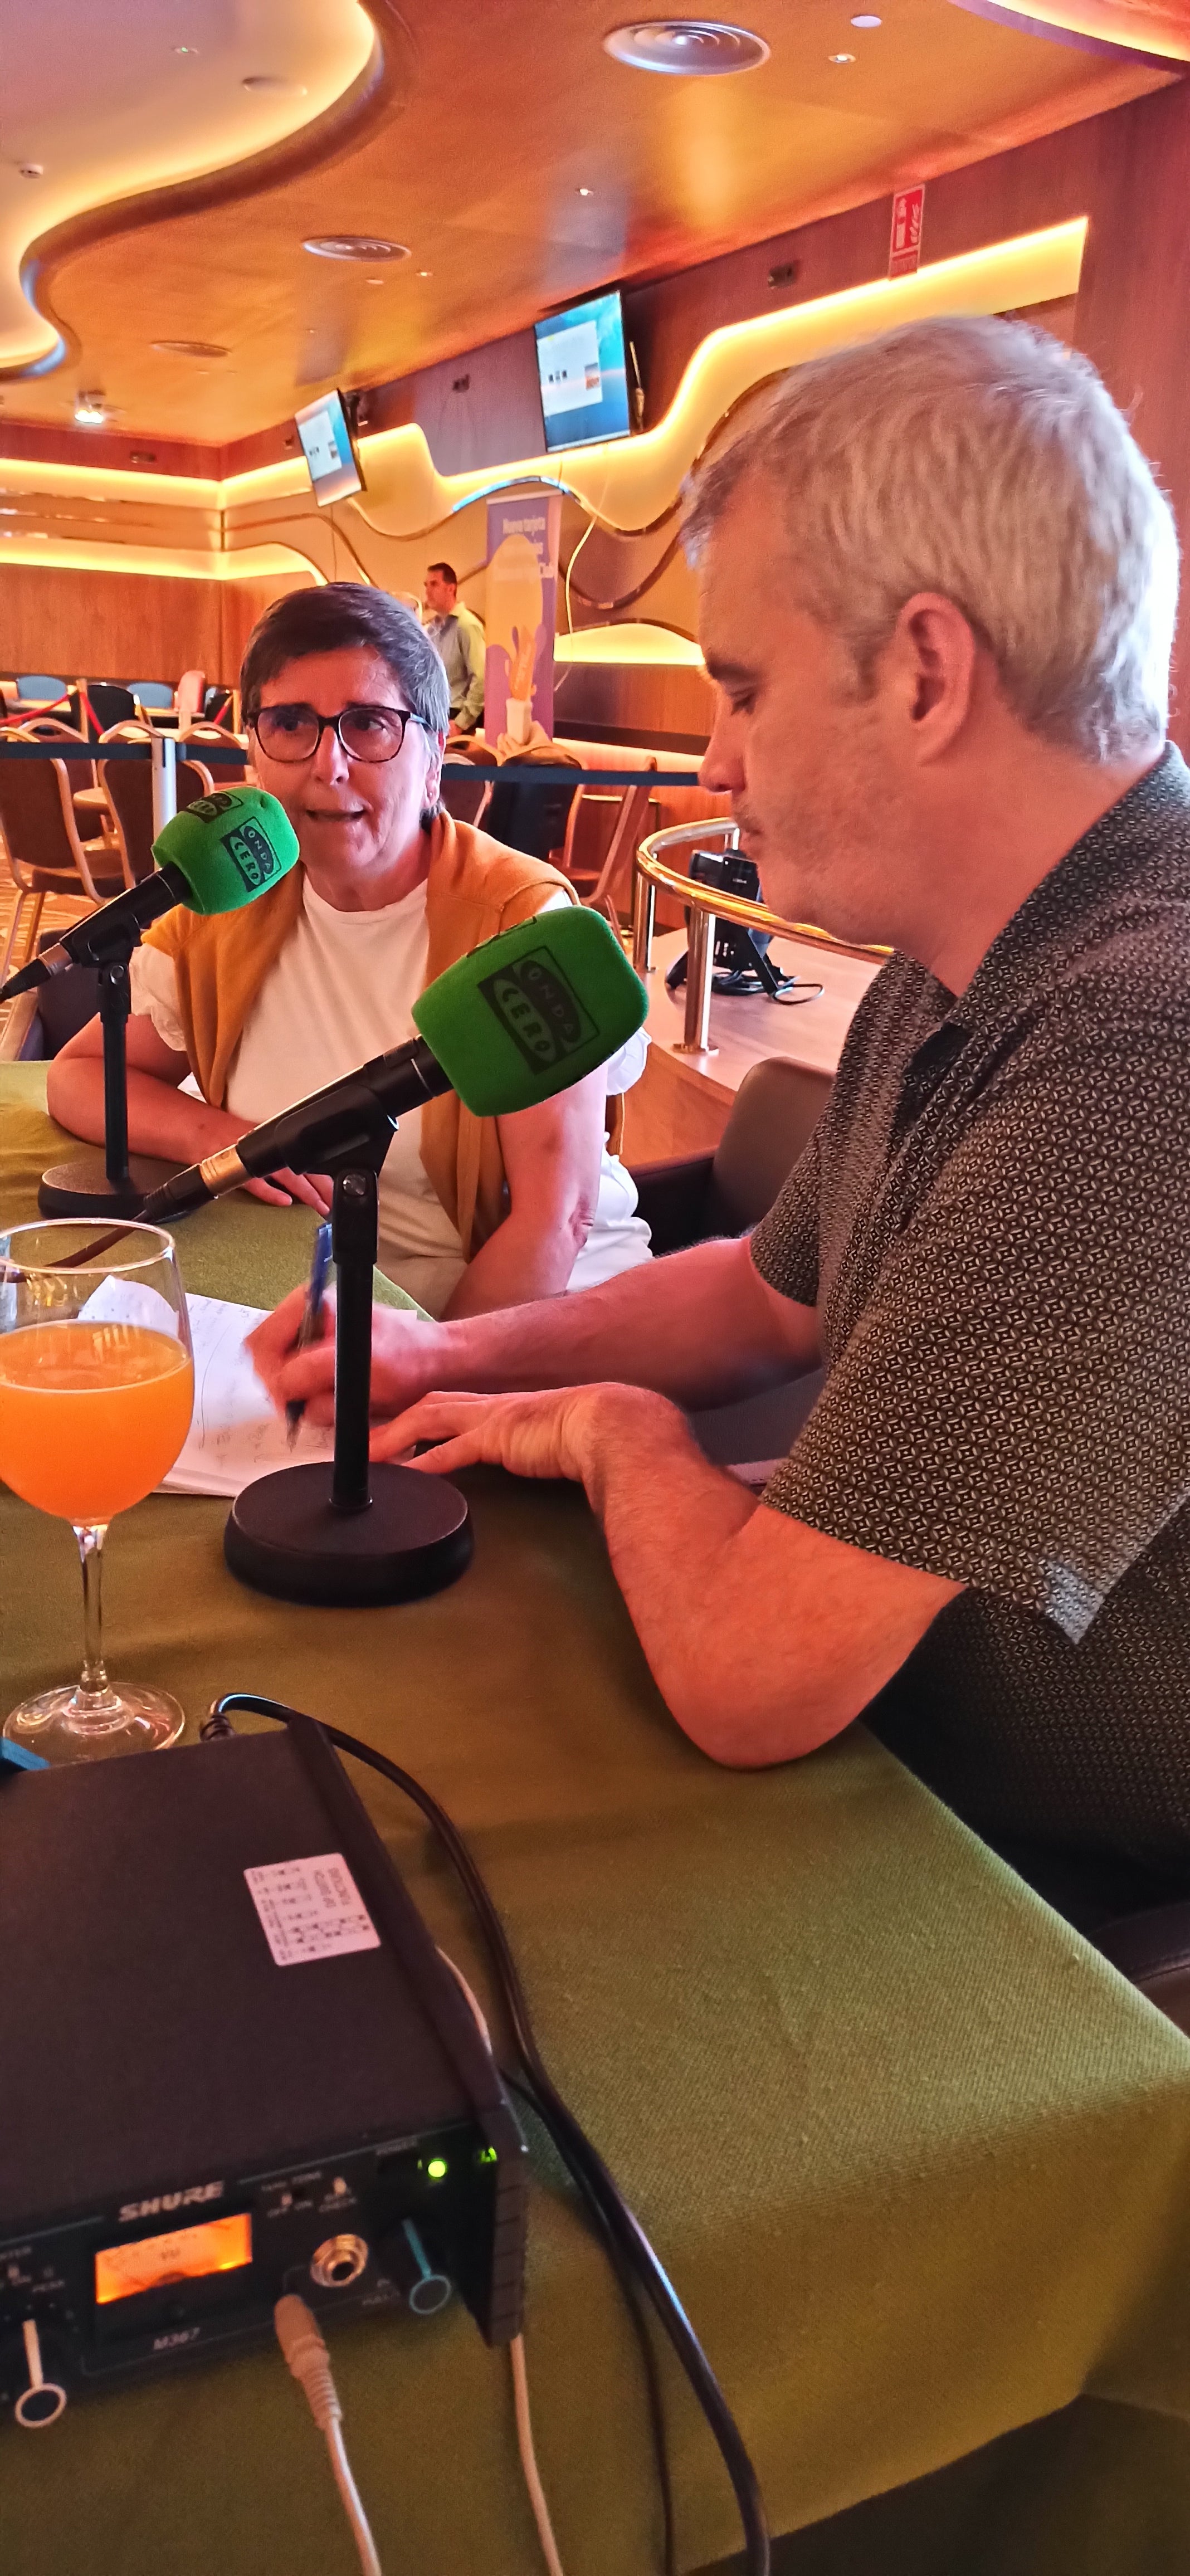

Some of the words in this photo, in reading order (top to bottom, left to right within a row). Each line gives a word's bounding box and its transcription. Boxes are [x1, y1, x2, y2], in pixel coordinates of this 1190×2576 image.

[234, 842, 259, 880] CERO
[248, 830, 271, 870] ONDA
[502, 988, 550, 1052] CERO
[530, 967, 574, 1035] ONDA
[118, 2180, 224, 2223] SHURE
